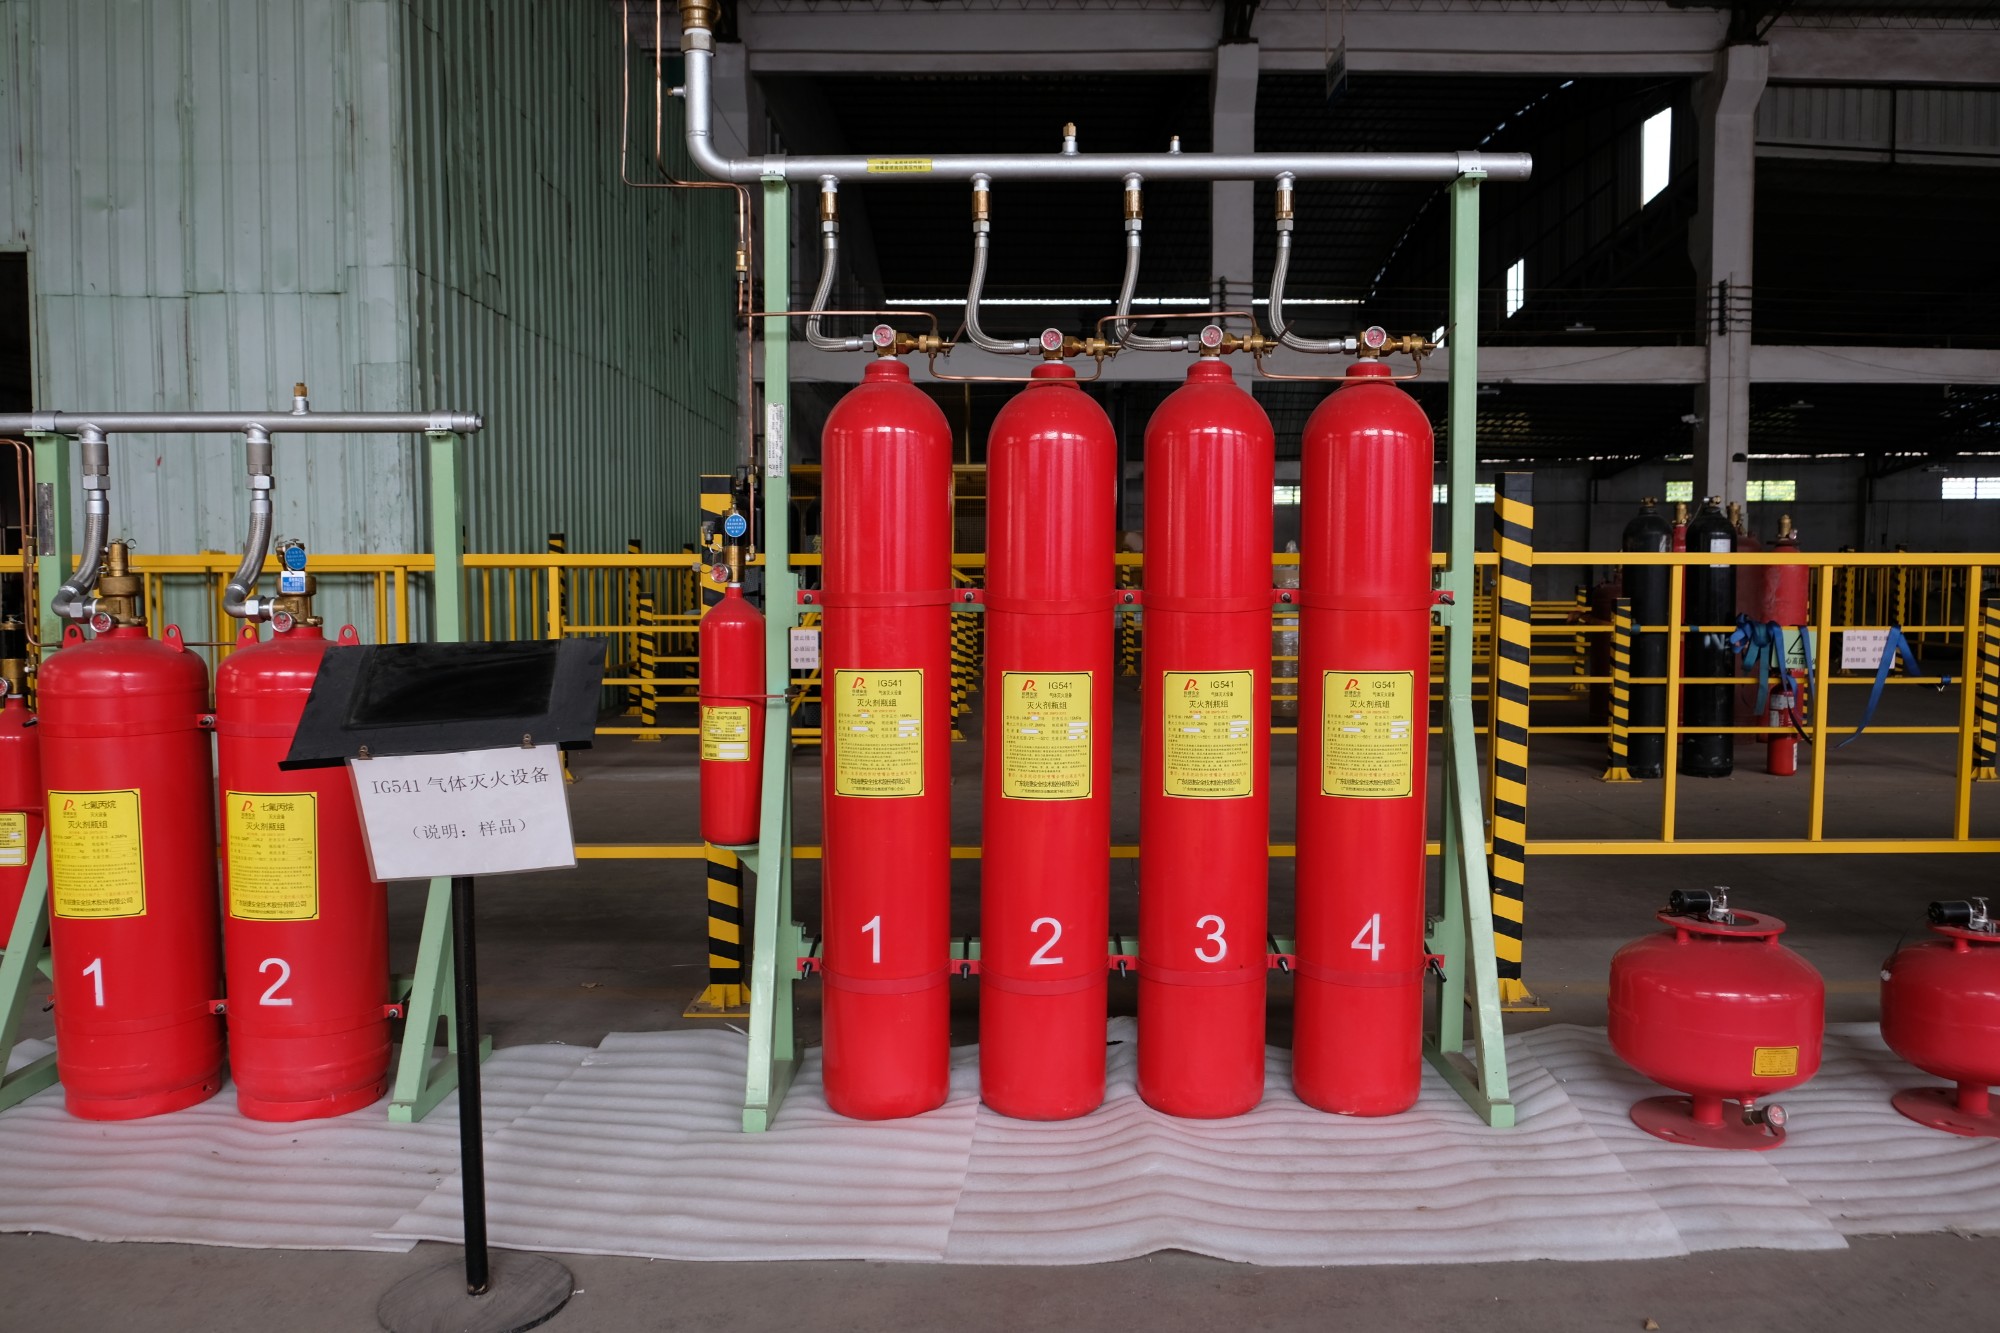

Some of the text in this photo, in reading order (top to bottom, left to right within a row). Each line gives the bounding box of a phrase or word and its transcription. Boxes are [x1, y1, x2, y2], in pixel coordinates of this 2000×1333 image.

[878, 680, 902, 688] IG541
[1048, 682, 1073, 690] IG541
[1210, 680, 1234, 688] IG541
[857, 698, 897, 707] 灭火剂瓶组
[1027, 701, 1067, 710] 灭火剂瓶组
[1189, 700, 1229, 708] 灭火剂瓶组
[1350, 700, 1390, 708] 灭火剂瓶组
[372, 766, 550, 794] IG541 气体灭火设备
[82, 800, 116, 810] 七氟丙烷
[261, 802, 294, 812] 七氟丙烷
[68, 821, 108, 829] 灭火剂瓶组
[246, 822, 286, 831] 灭火剂瓶组
[860, 915, 882, 964] 1
[1028, 917, 1064, 966] 2
[1194, 914, 1228, 964] 3
[1350, 913, 1386, 961] 4
[82, 958, 104, 1006] 1
[258, 957, 293, 1006] 2
